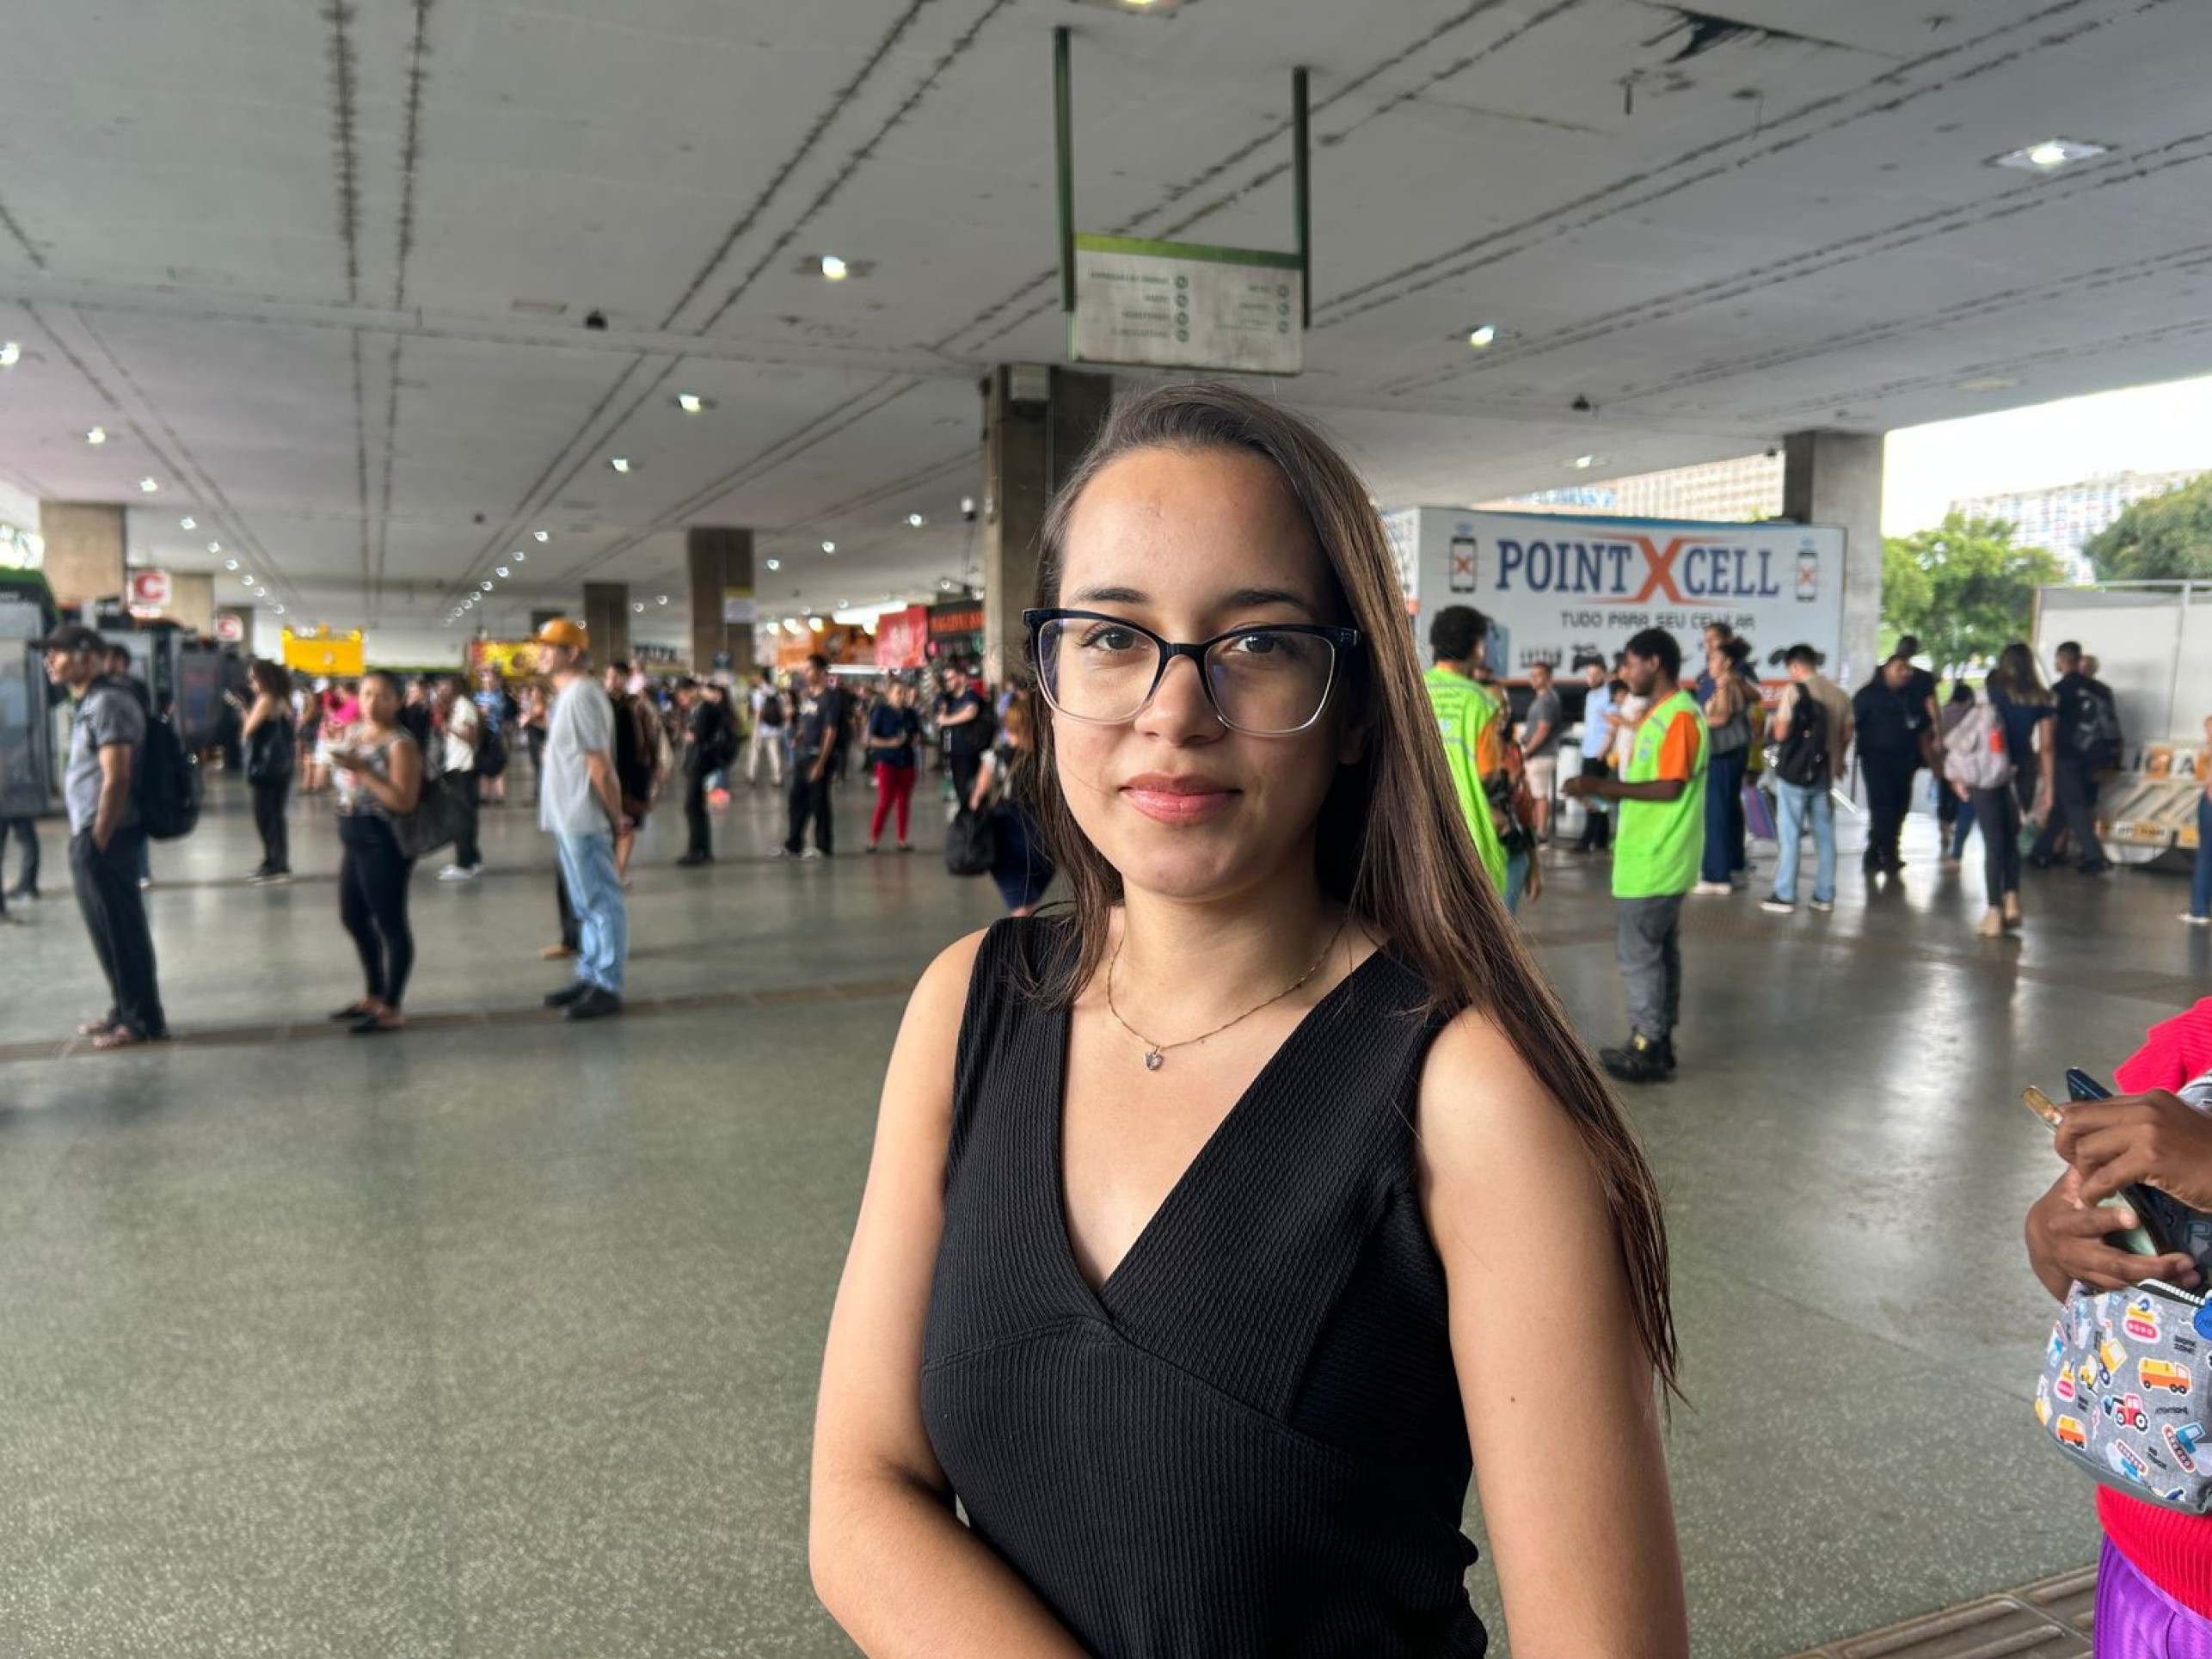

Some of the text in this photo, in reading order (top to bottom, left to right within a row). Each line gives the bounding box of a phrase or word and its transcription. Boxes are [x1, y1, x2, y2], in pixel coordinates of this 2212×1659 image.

[136, 572, 165, 599] C
[1561, 611, 1602, 629] TUDO
[1608, 611, 1649, 630] PARA
[1656, 611, 1686, 630] SEU
